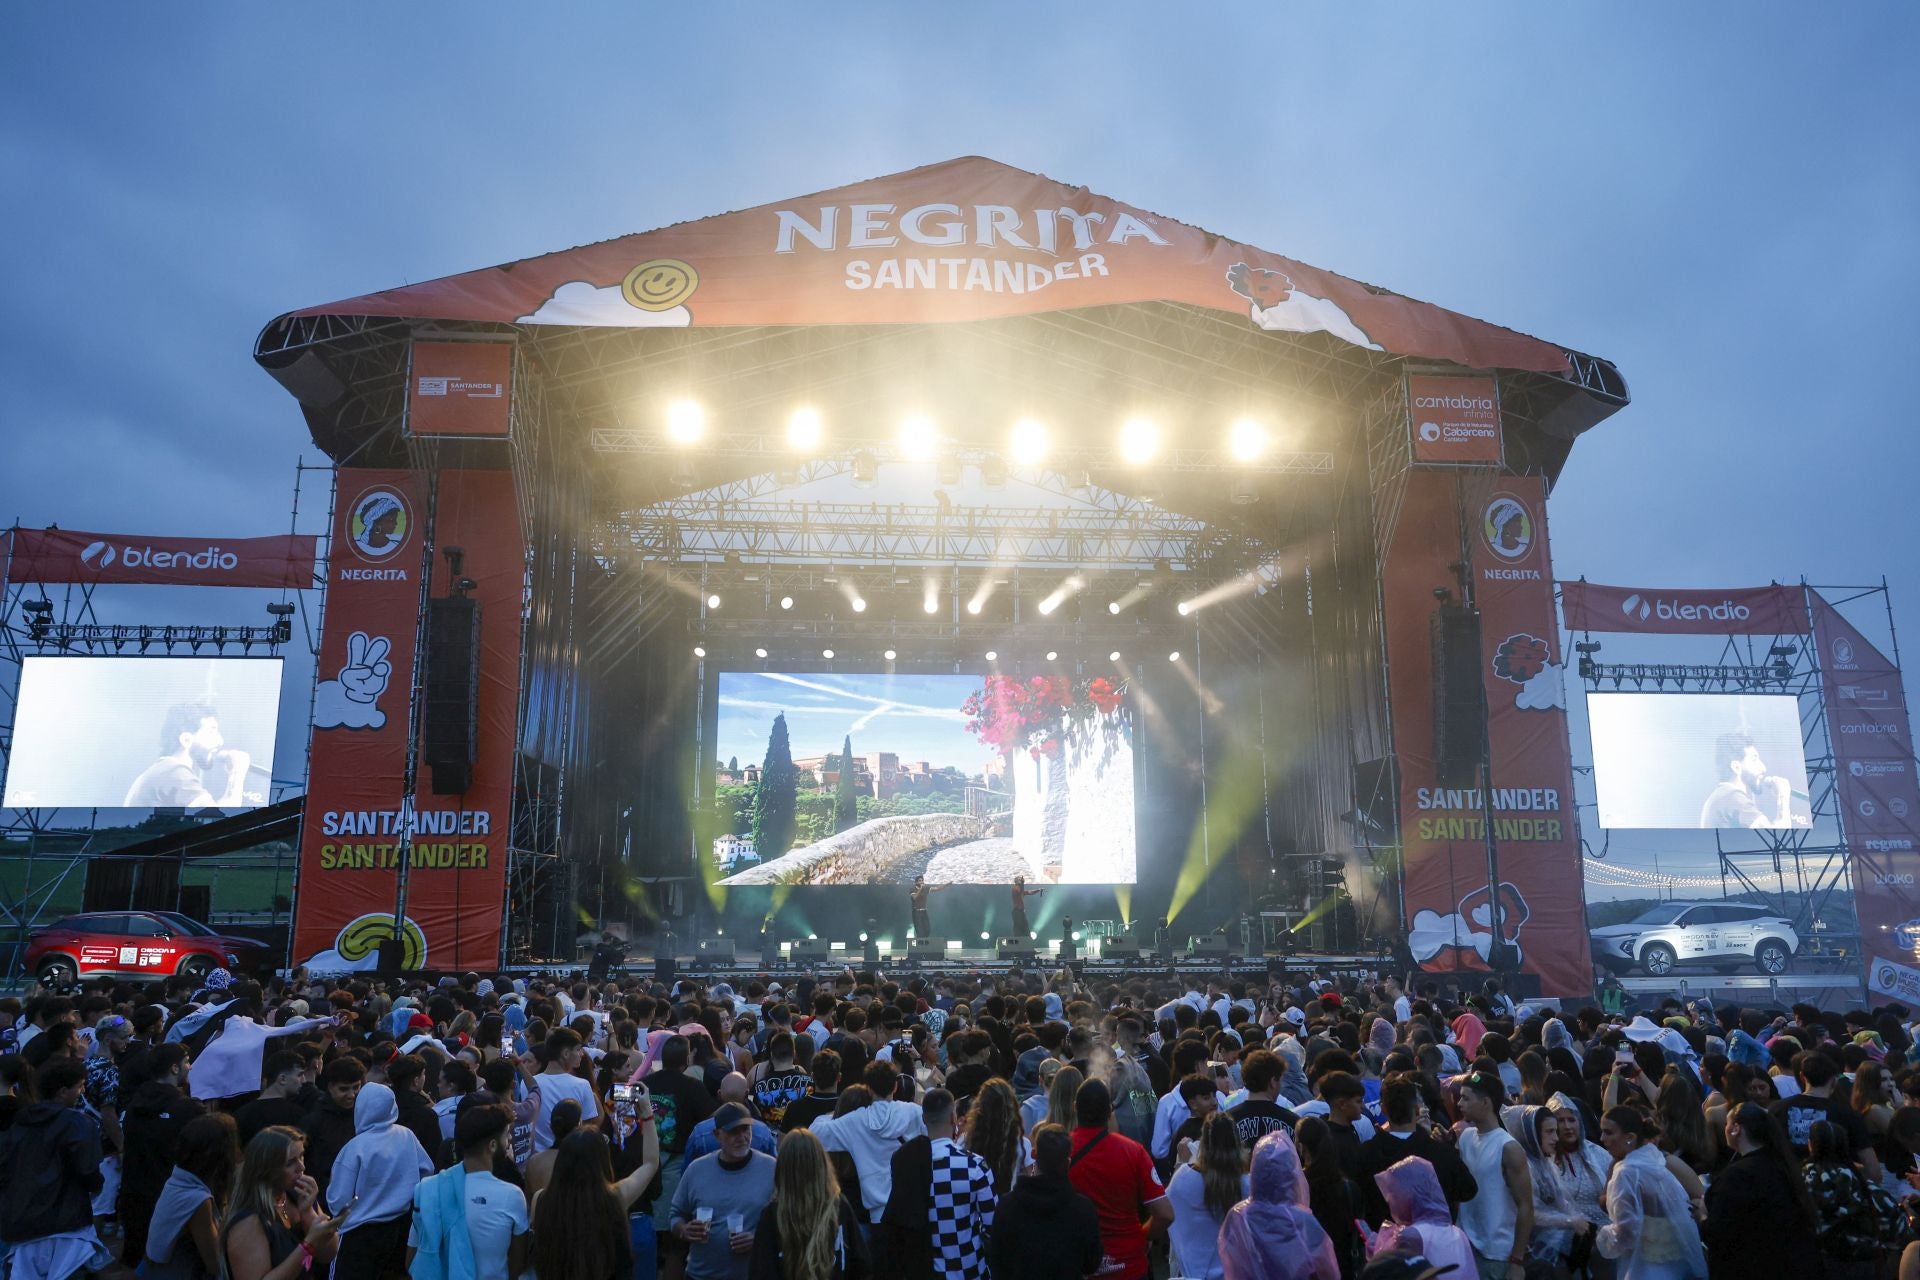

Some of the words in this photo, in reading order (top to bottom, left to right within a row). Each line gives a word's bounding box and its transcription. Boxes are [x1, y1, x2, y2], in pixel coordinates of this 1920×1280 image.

[774, 203, 1174, 256] NEGRITA
[845, 253, 1109, 294] SANTANDER
[1415, 395, 1493, 410] cantabria
[1443, 427, 1495, 438] Cabarceno
[122, 546, 238, 570] blendio
[341, 569, 408, 581] NEGRITA
[1484, 569, 1541, 580] NEGRITA
[1656, 600, 1750, 620] blendio
[1840, 721, 1897, 733] cantabria
